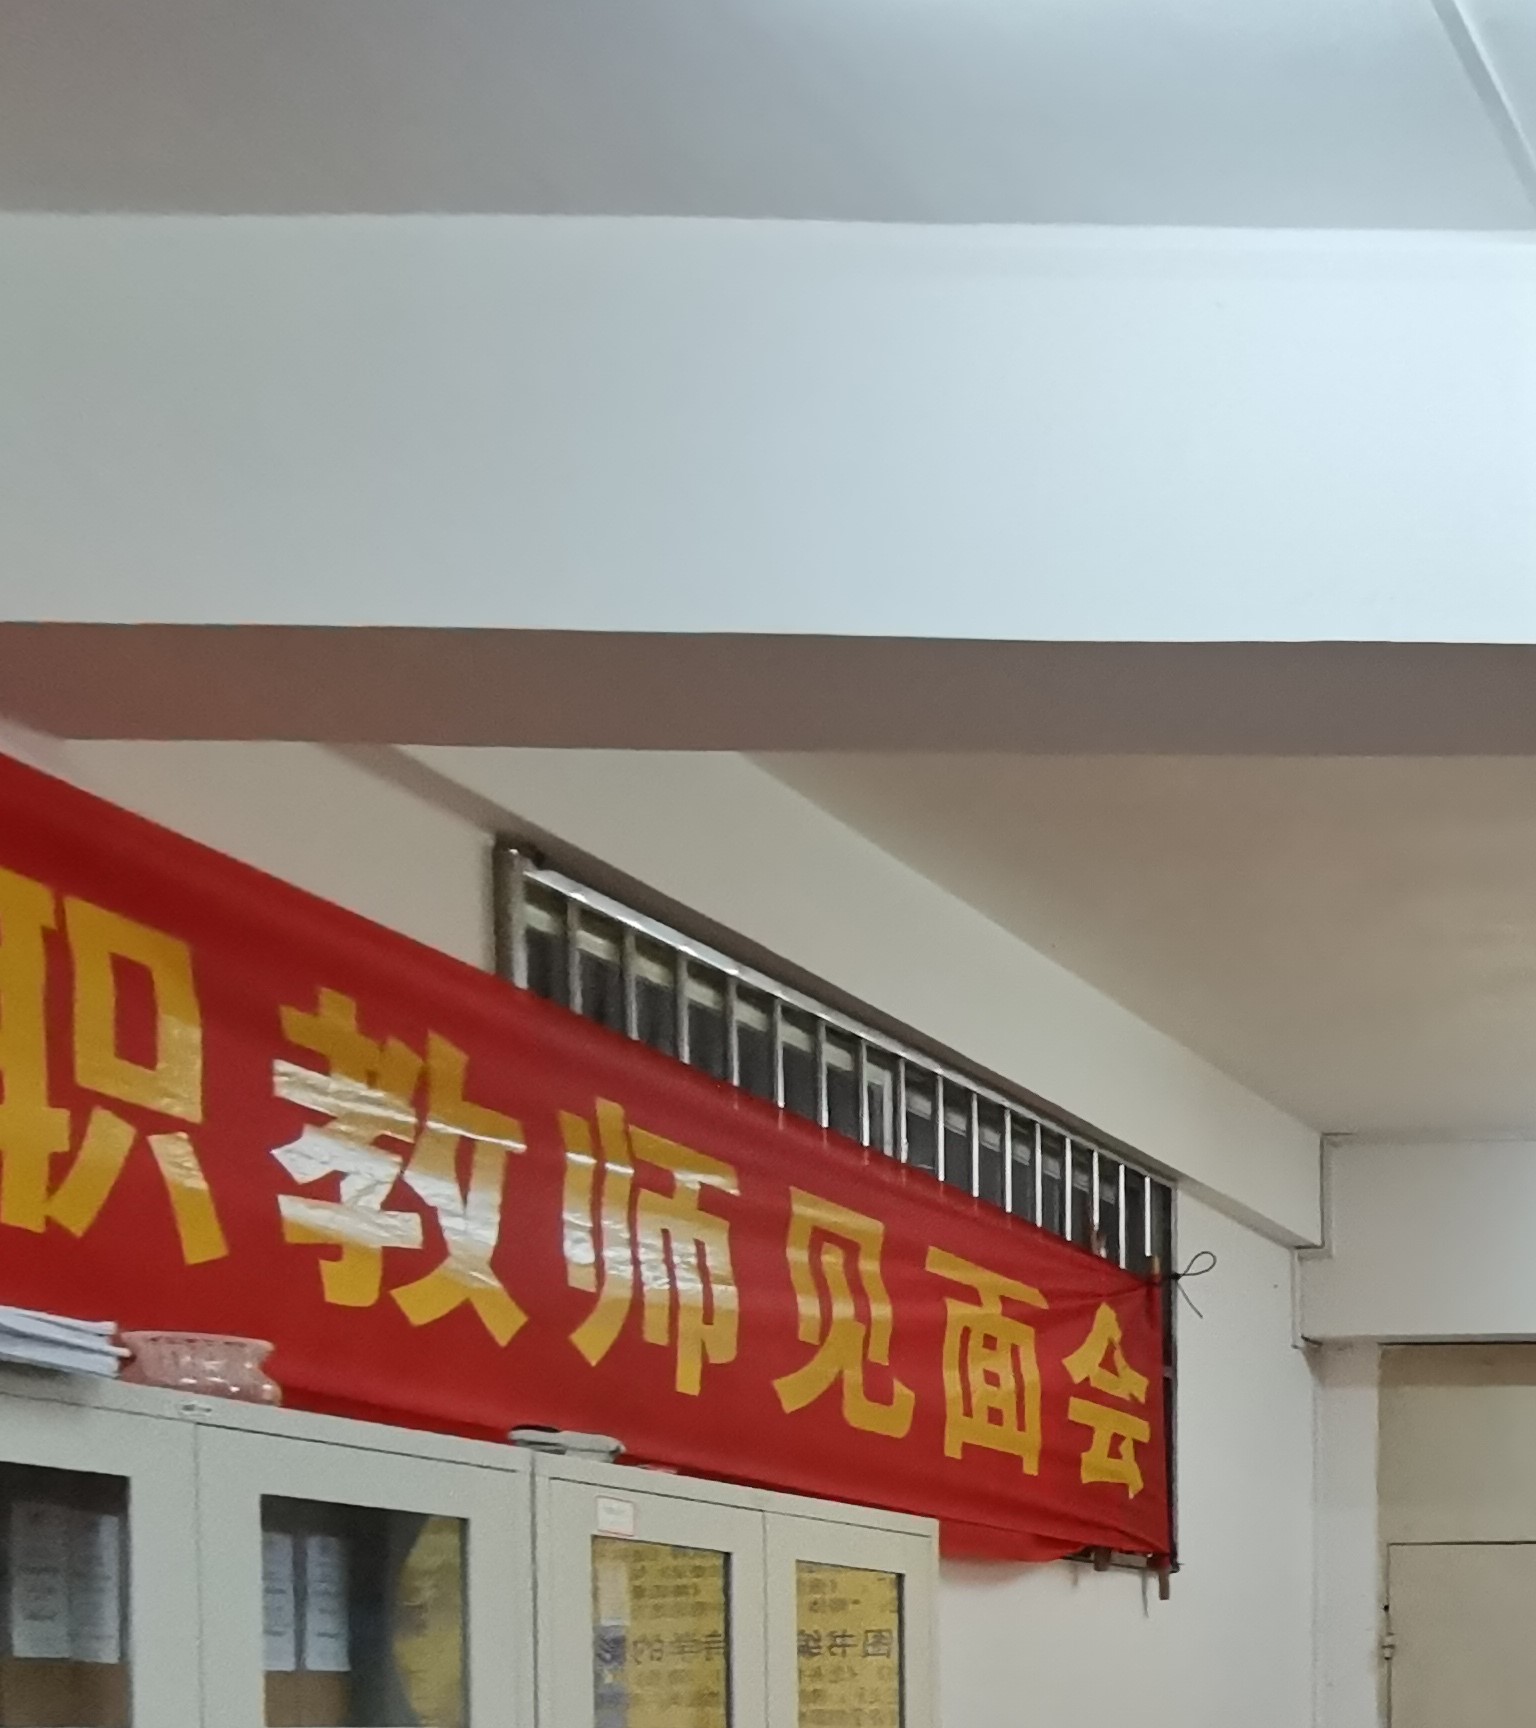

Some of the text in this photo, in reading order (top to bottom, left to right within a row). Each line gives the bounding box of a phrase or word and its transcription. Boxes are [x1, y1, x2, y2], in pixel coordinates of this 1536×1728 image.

[0, 868, 1151, 1499] 职教师见面会
